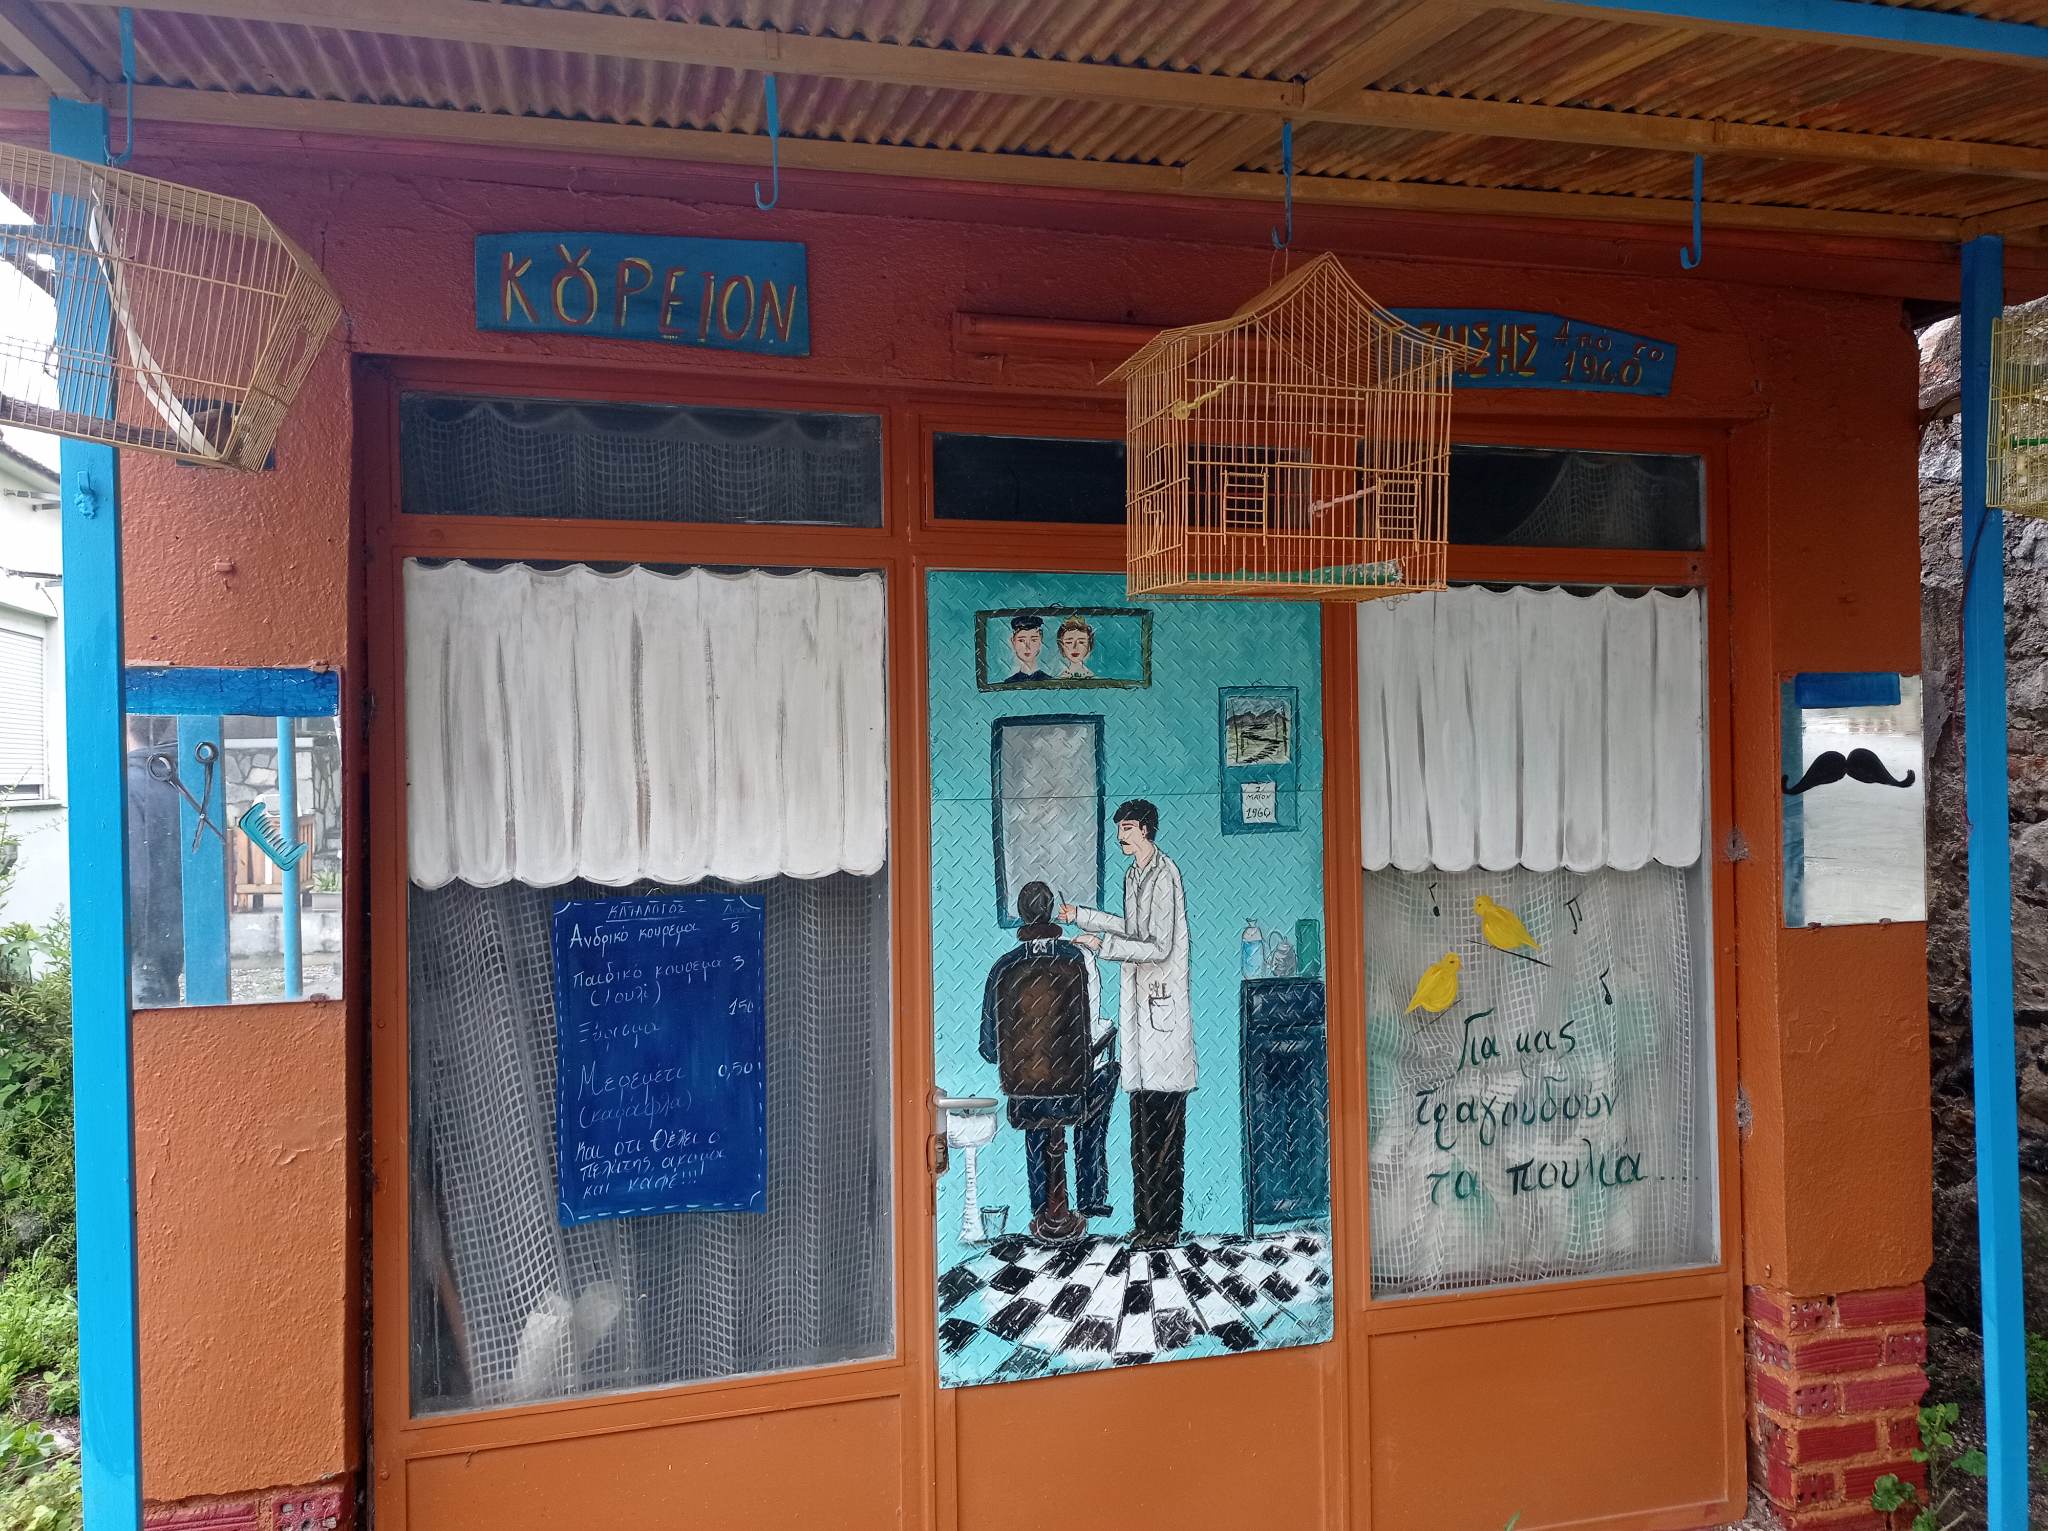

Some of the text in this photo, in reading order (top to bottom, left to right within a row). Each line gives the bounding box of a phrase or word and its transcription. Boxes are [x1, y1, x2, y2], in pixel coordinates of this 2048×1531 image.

[1560, 350, 1644, 387] 1960
[1246, 807, 1271, 819] 1960
[569, 923, 629, 958] Ανδρικό
[730, 920, 740, 933] 5
[732, 955, 745, 971] 3
[1457, 1007, 1577, 1077] Για μας
[718, 1062, 753, 1080] 0,50
[1427, 1169, 1479, 1205] τα
